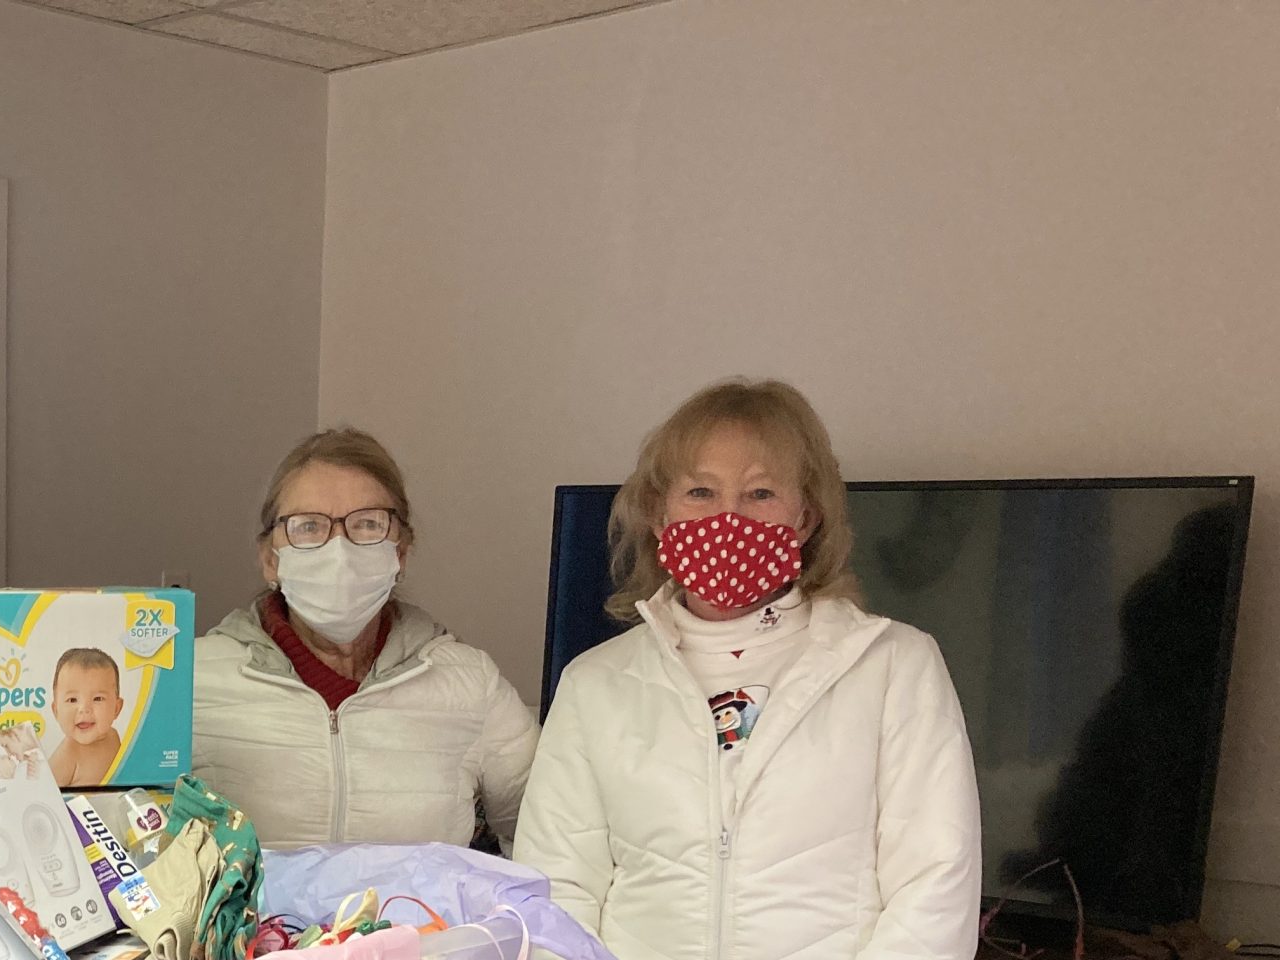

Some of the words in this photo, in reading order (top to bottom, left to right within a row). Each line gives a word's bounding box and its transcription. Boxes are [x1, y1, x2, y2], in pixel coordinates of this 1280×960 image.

[135, 609, 163, 627] 2X
[131, 627, 168, 638] SOFTER
[83, 810, 137, 877] Desitin
